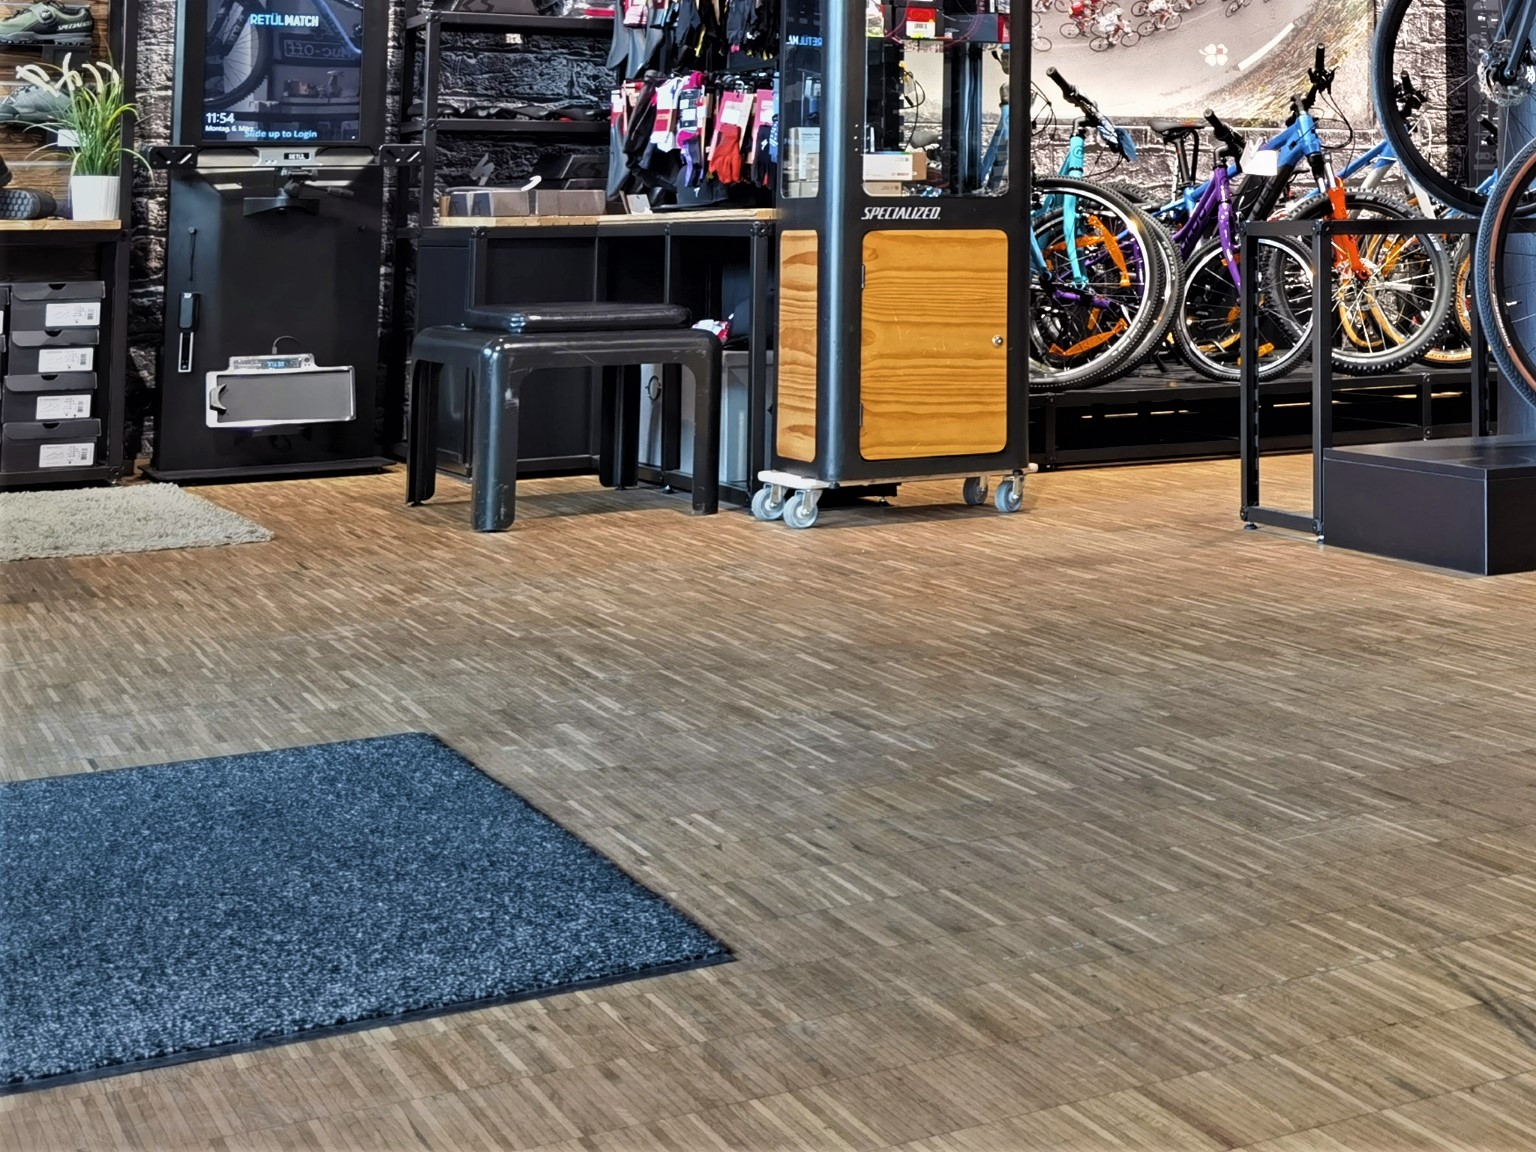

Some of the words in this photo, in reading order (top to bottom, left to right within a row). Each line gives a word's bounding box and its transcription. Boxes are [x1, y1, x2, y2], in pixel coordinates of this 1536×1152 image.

[206, 112, 235, 124] 11:54
[244, 130, 267, 138] Slide
[268, 131, 280, 139] up
[282, 130, 292, 138] to
[293, 130, 318, 139] Login
[861, 206, 941, 220] SPECIALIZED
